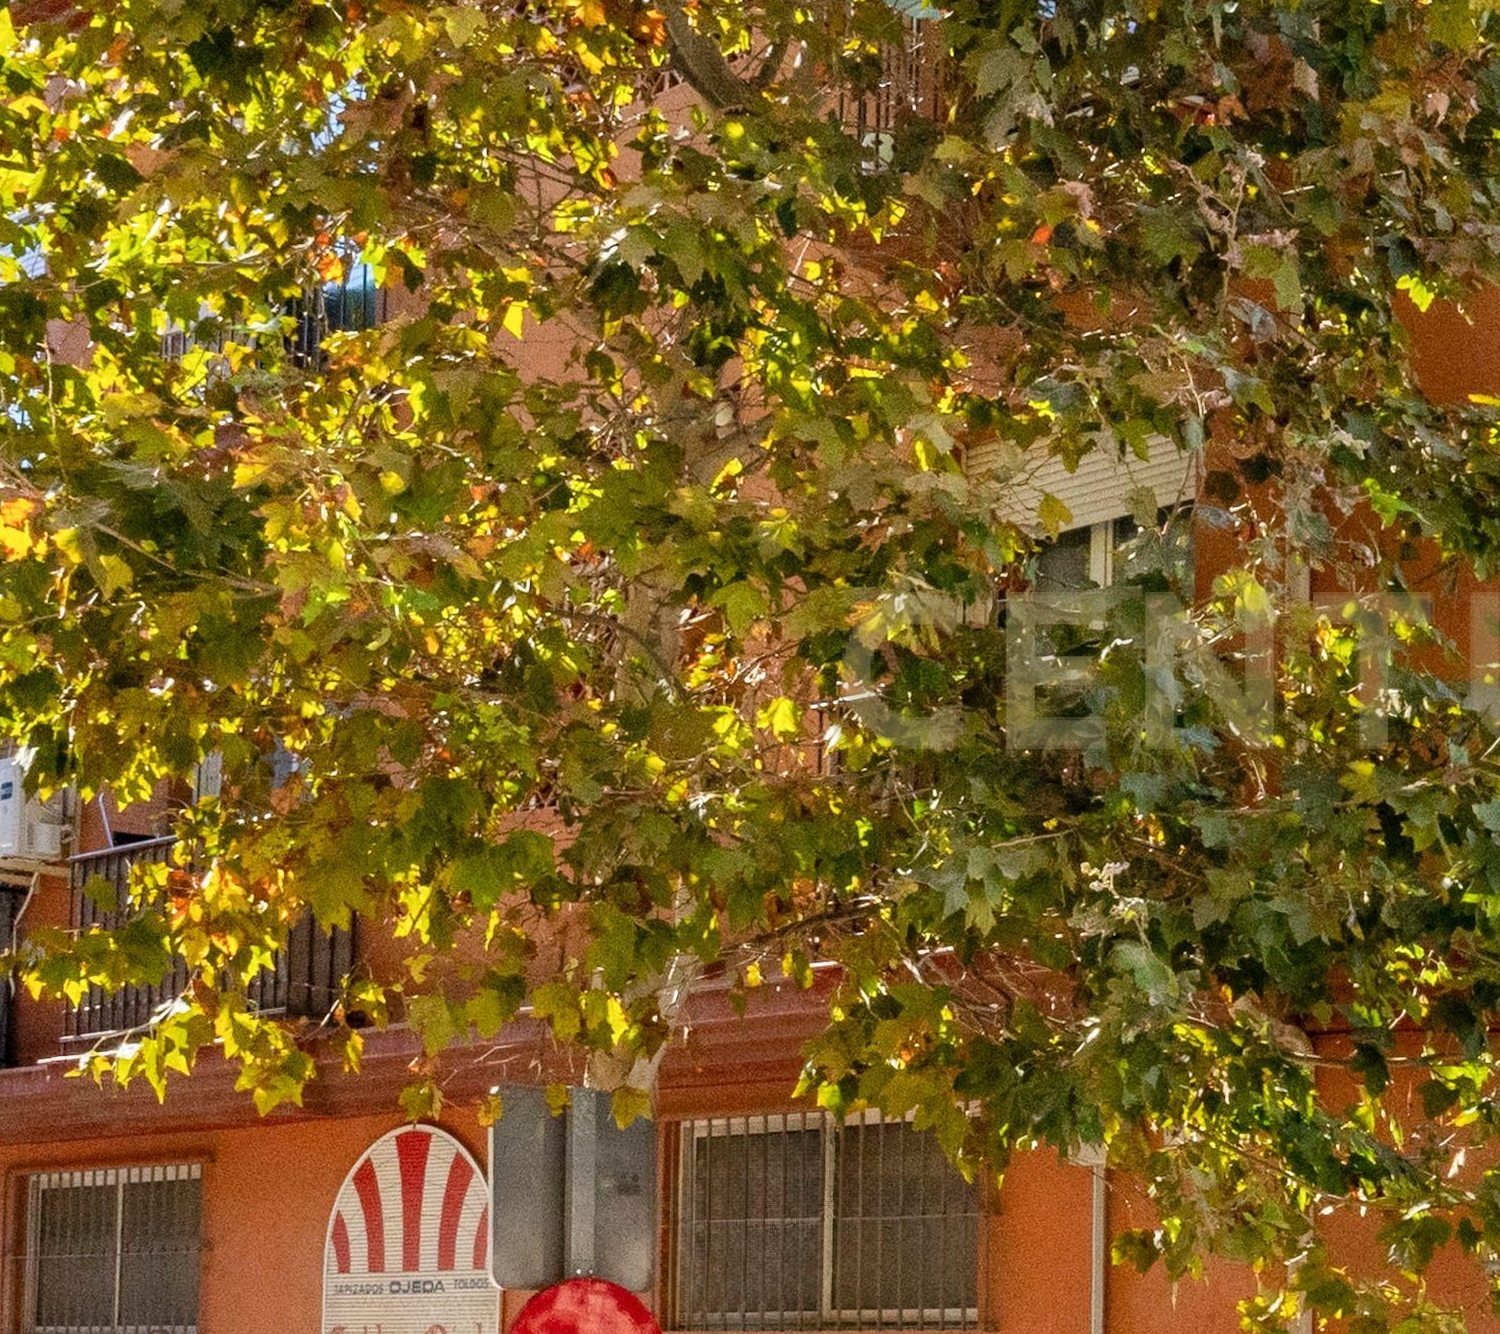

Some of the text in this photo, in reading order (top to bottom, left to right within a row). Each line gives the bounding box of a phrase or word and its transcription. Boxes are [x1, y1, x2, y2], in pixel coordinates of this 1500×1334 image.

[334, 1278, 489, 1295] TAPIZADOS OJEDA TOLDOS
